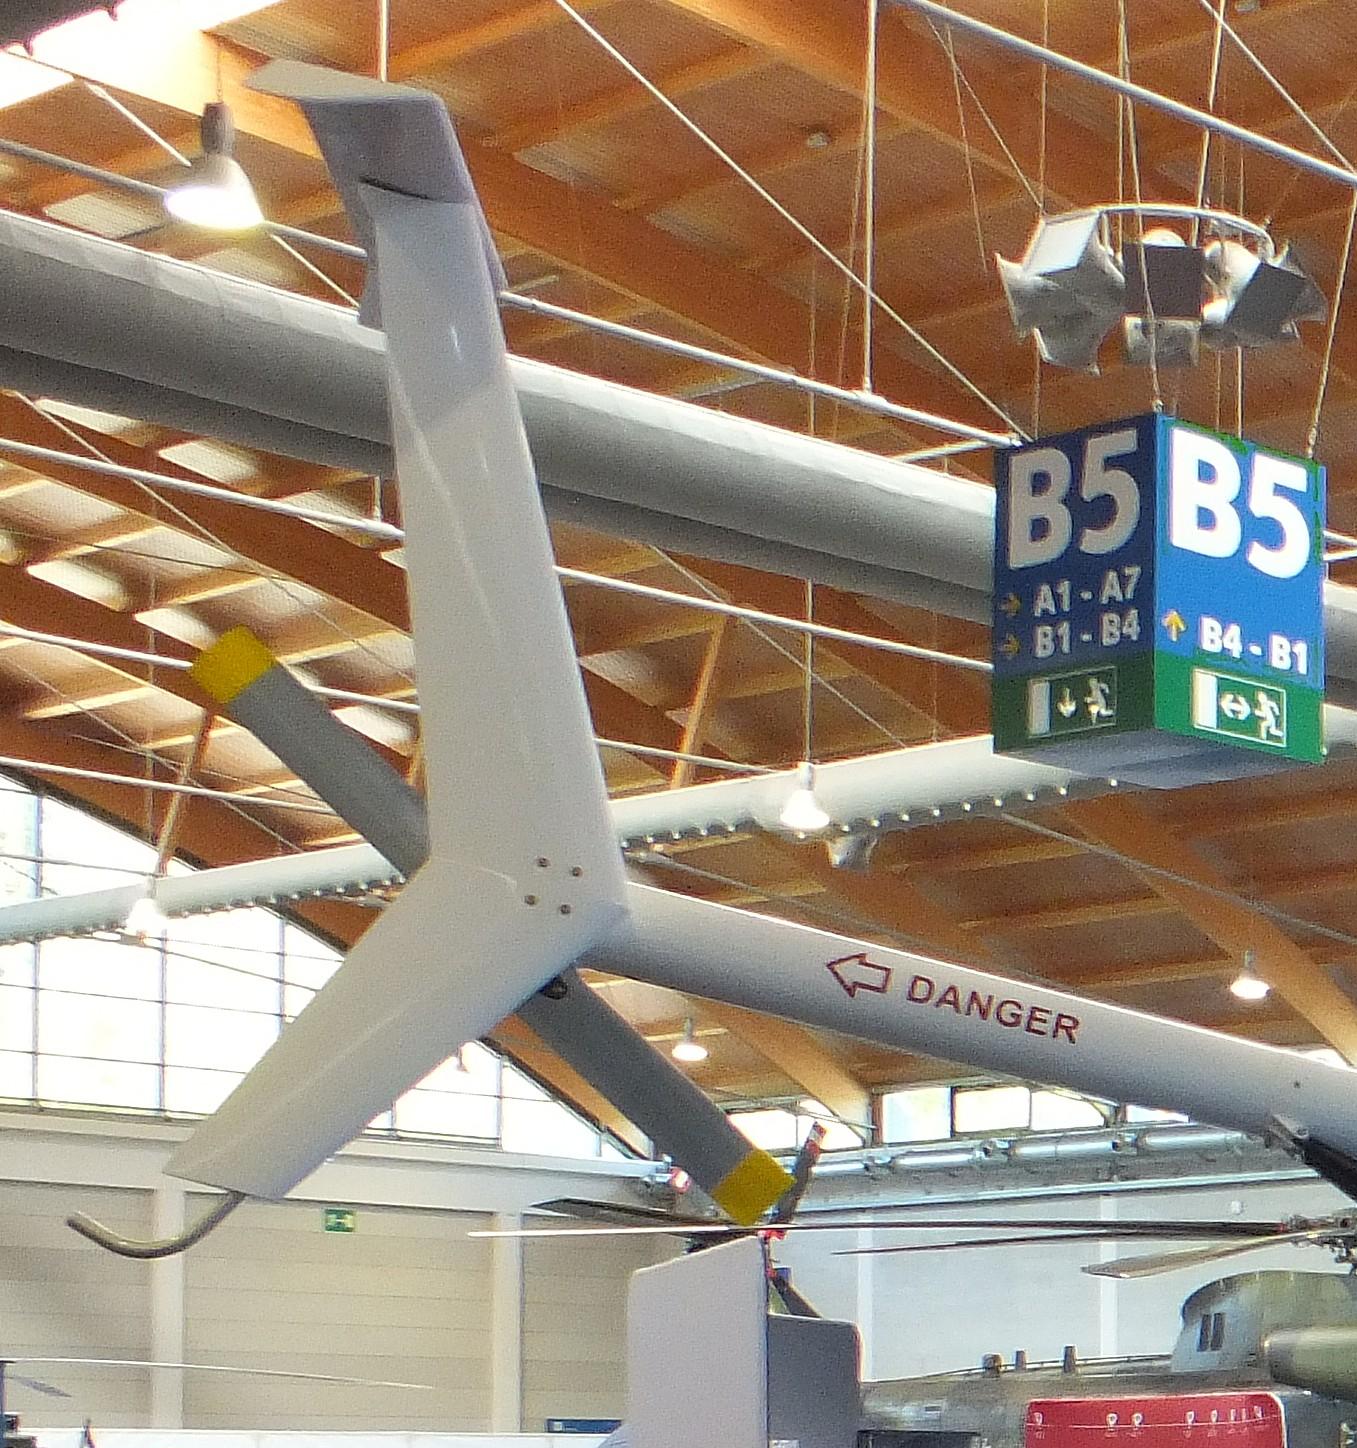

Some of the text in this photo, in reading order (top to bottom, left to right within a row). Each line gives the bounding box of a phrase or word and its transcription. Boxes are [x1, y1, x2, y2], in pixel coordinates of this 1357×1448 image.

[1008, 428, 1142, 570] B5
[1170, 426, 1312, 580] B5
[1033, 579, 1072, 618] A1
[1101, 565, 1142, 606] A7
[1034, 620, 1072, 659] B1
[1101, 607, 1142, 648] B4
[1200, 615, 1243, 660] B4
[1270, 630, 1310, 676] B1
[906, 974, 1082, 1046] DANGER
